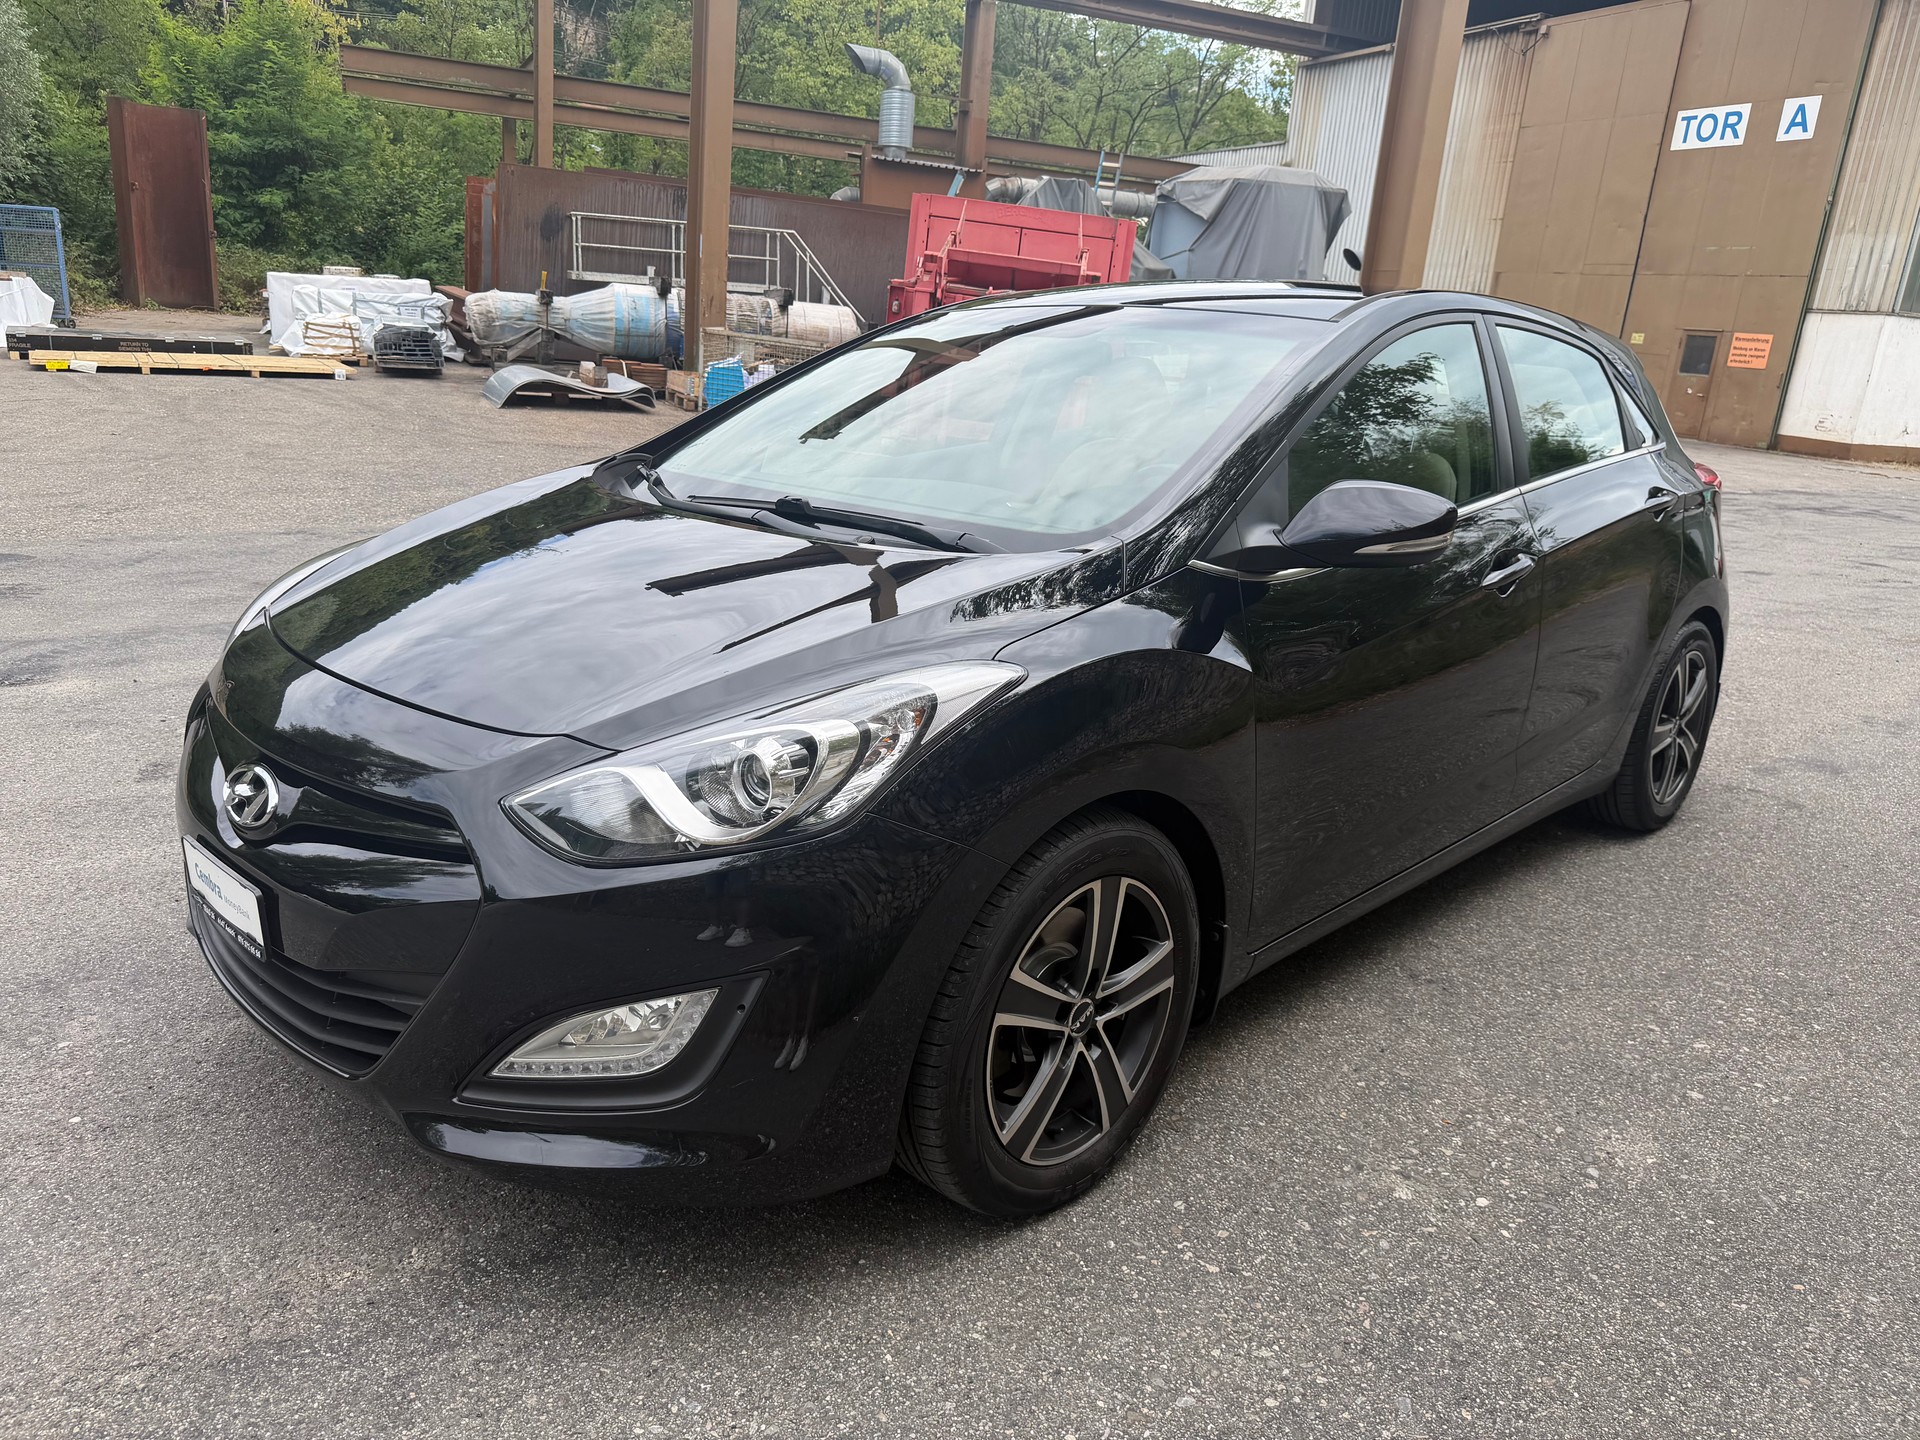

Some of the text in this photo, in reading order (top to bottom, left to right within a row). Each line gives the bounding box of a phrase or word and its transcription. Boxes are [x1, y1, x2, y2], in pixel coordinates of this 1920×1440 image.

[1681, 103, 1809, 144] TOR A
[194, 862, 223, 900] Cembra
